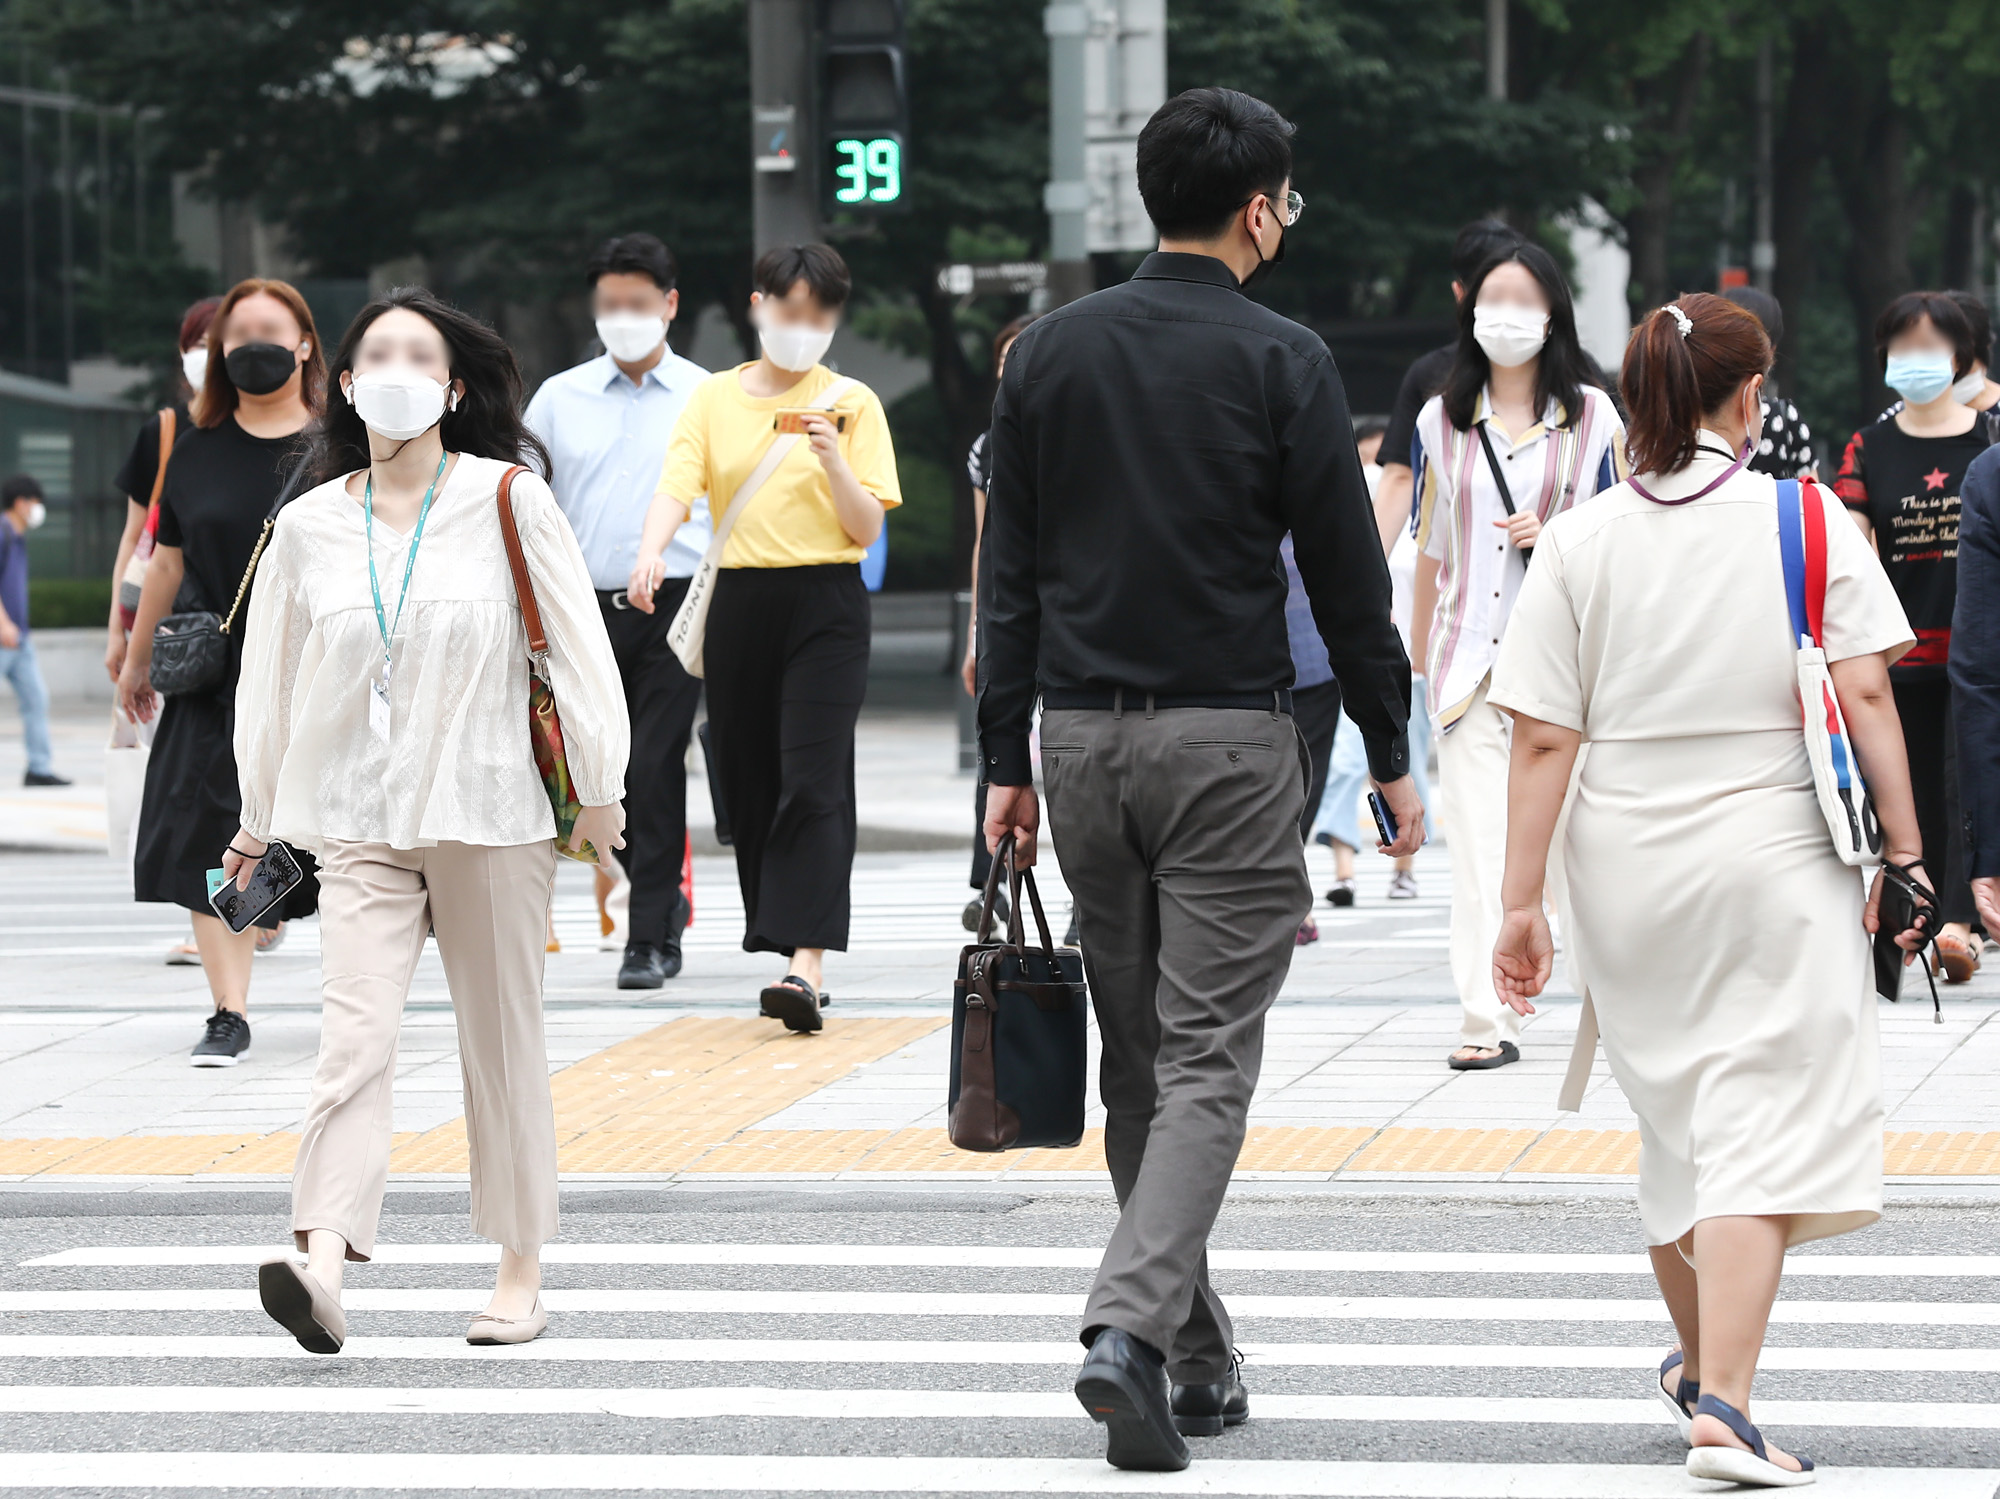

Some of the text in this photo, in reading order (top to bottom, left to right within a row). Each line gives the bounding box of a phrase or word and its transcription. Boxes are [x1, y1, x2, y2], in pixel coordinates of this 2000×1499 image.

[836, 139, 901, 203] 39
[1901, 495, 1962, 511] This is you
[1892, 512, 1936, 530] Monday
[1895, 529, 1937, 544] reminder
[676, 562, 711, 643] KANGOL
